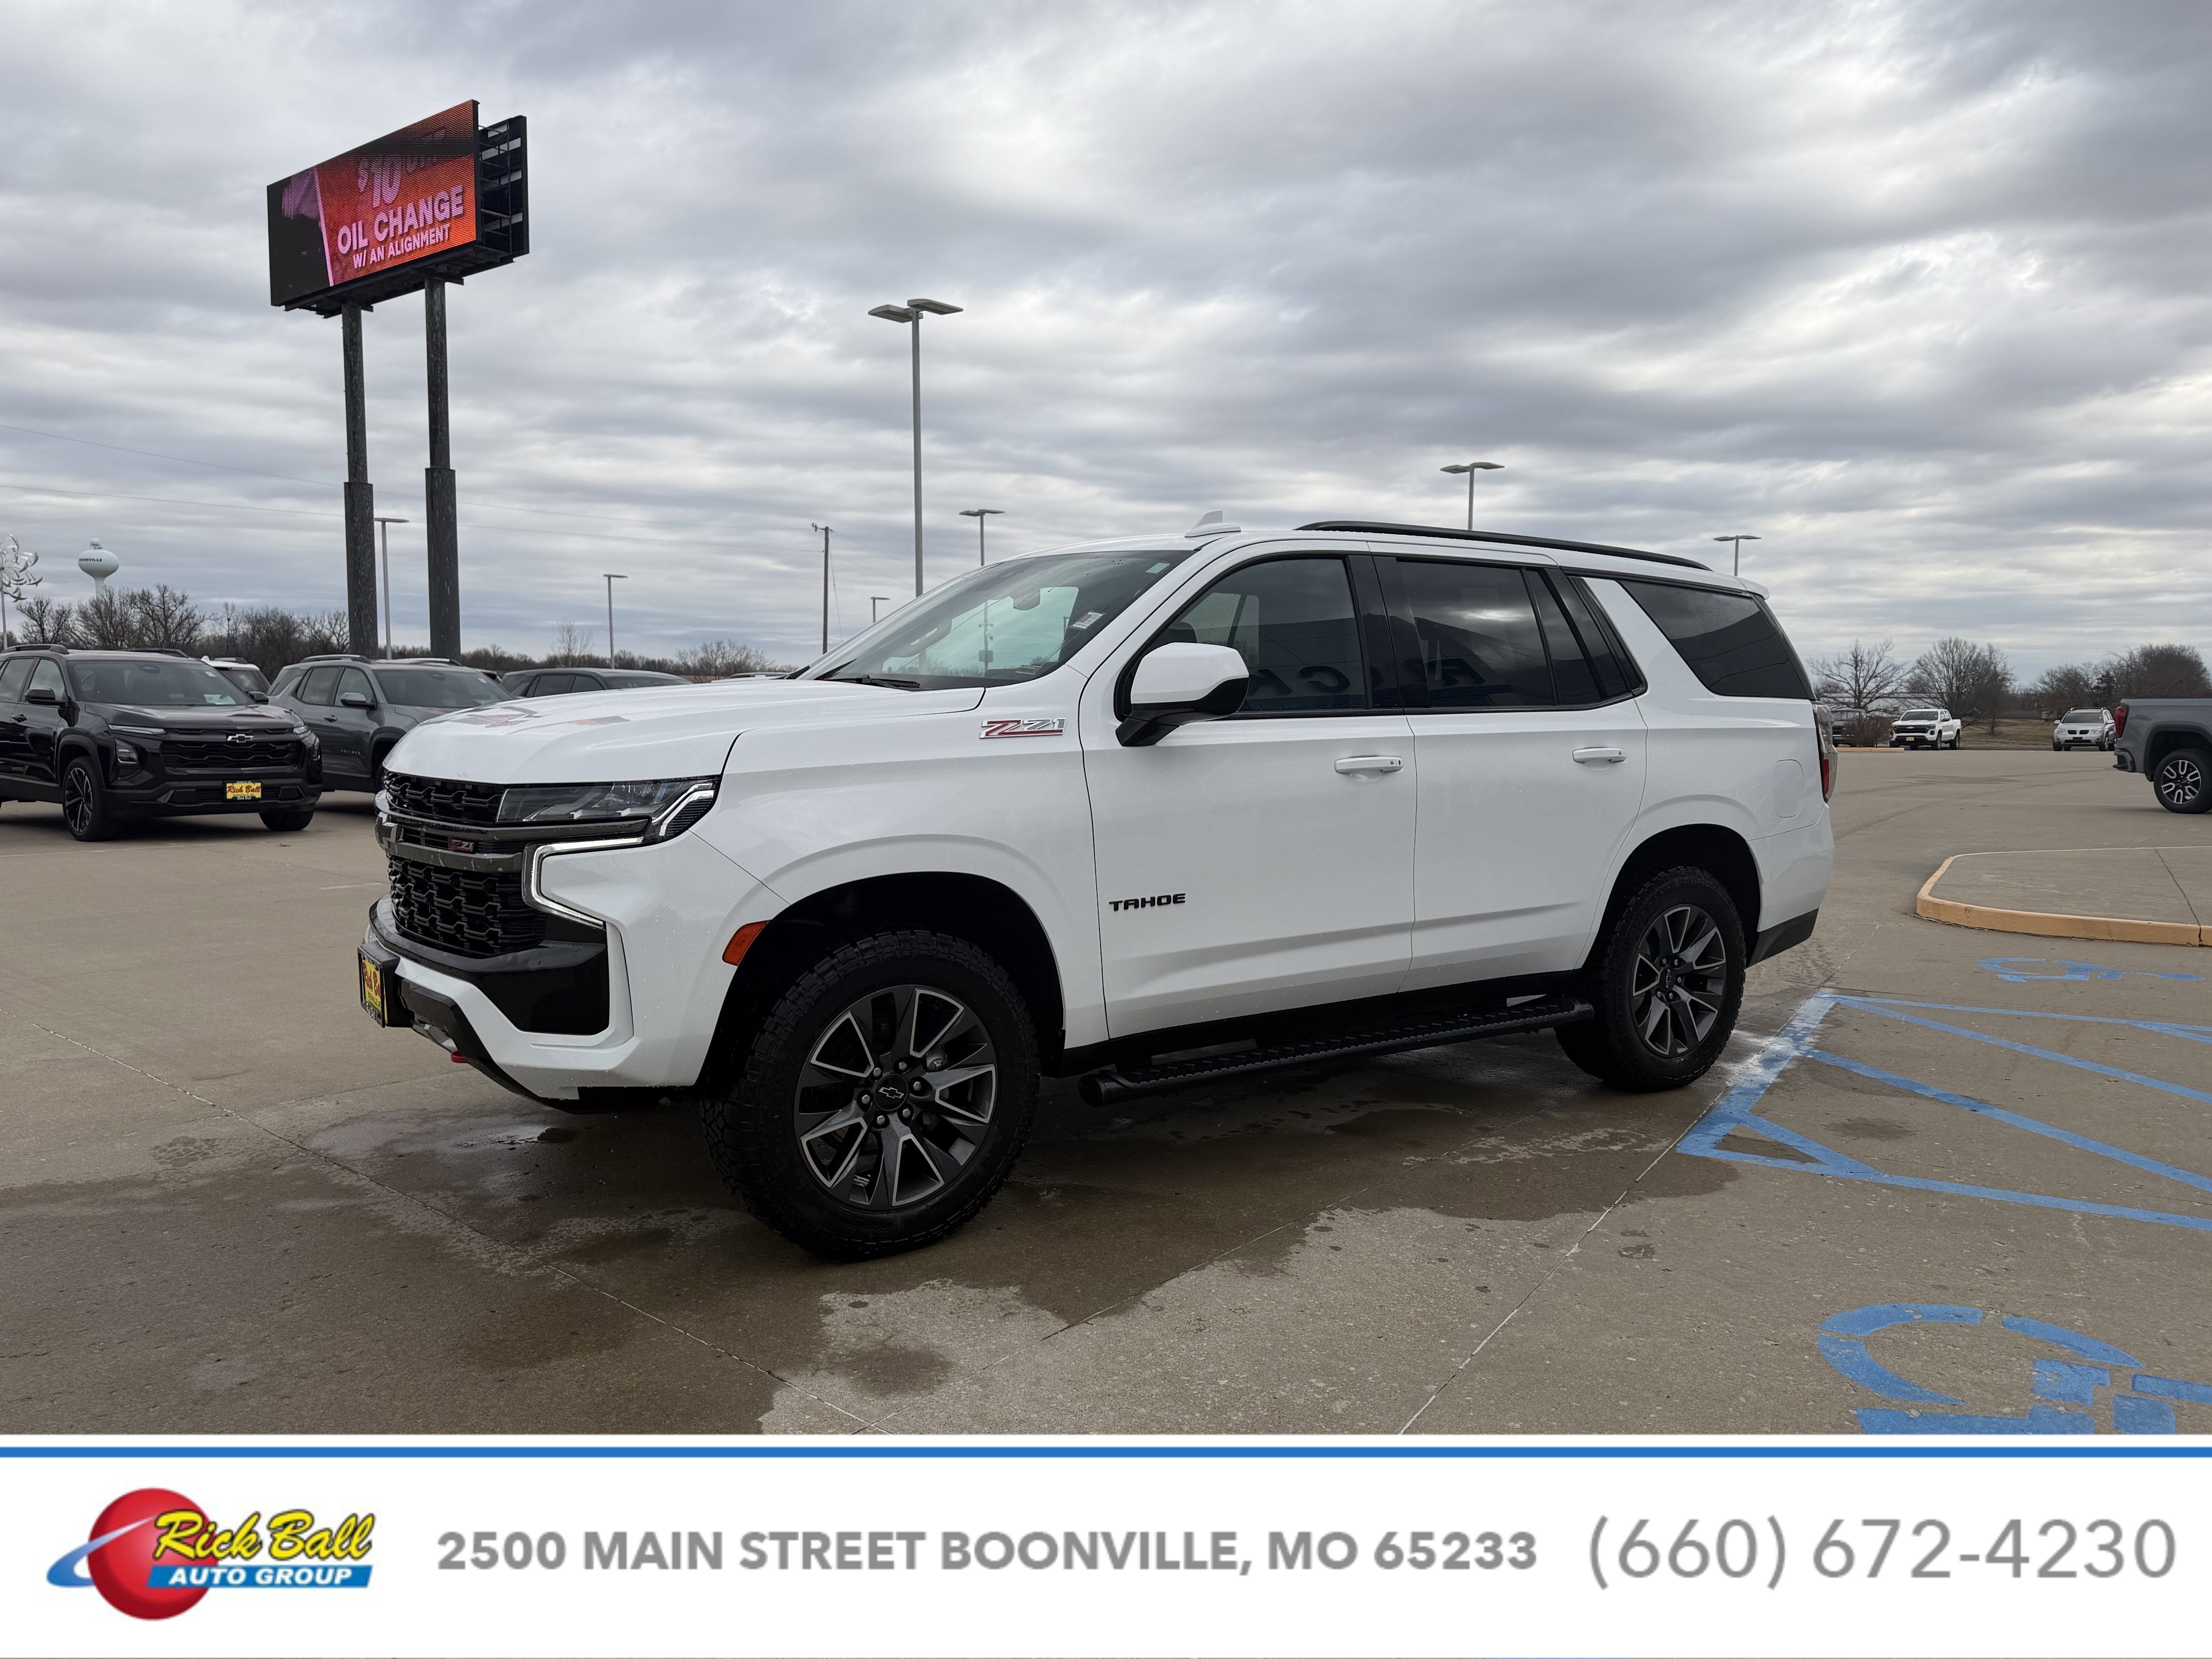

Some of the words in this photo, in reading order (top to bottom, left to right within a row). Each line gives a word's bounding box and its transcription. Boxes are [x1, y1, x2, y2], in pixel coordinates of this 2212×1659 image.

[337, 220, 369, 254] OIL
[373, 185, 464, 243] CHANGE
[352, 248, 368, 269] W/
[369, 246, 385, 264] AN
[387, 223, 451, 259] ALIGNMENT
[979, 718, 1066, 739] Z71
[1109, 893, 1186, 912] TAHOE
[373, 971, 381, 998] Ba
